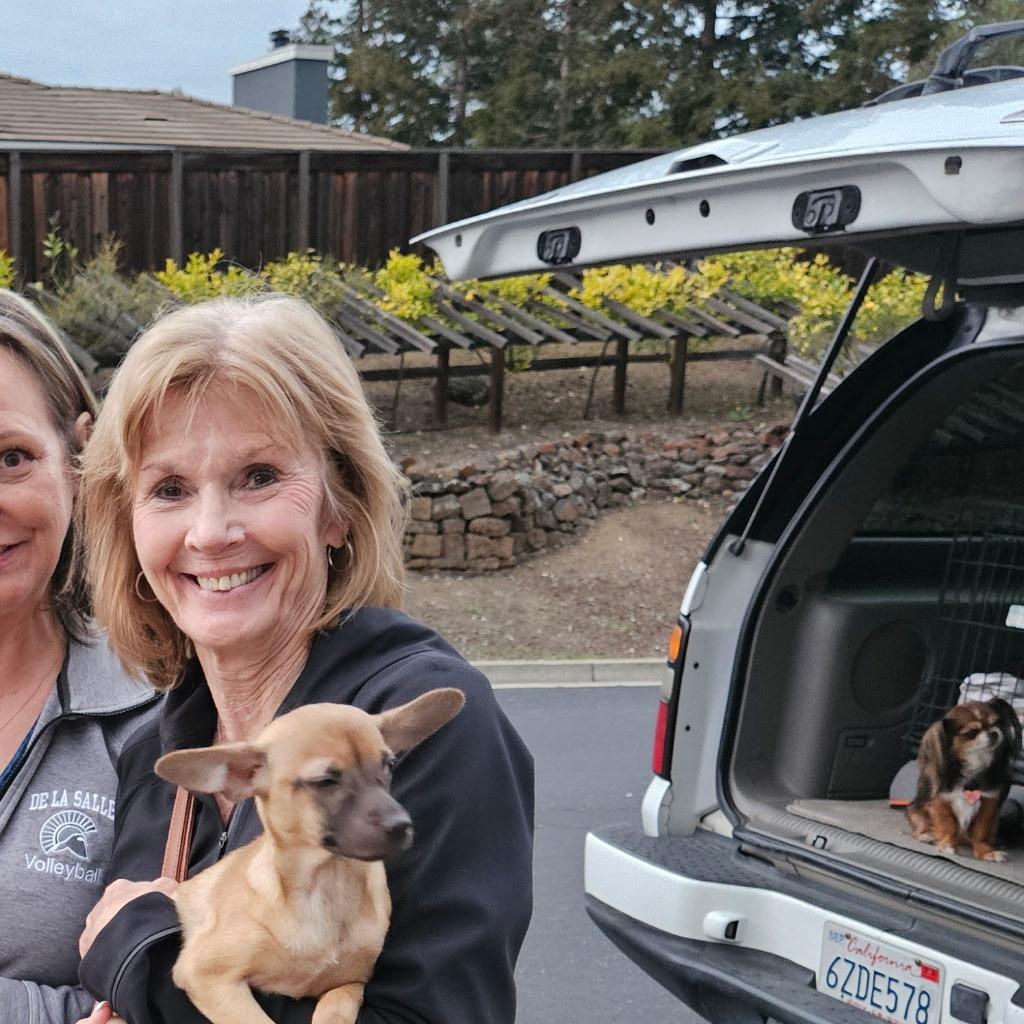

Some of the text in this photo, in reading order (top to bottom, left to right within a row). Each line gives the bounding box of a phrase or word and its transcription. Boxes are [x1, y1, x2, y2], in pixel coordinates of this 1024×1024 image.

[29, 789, 116, 820] DE LA SALLE
[847, 936, 916, 975] California
